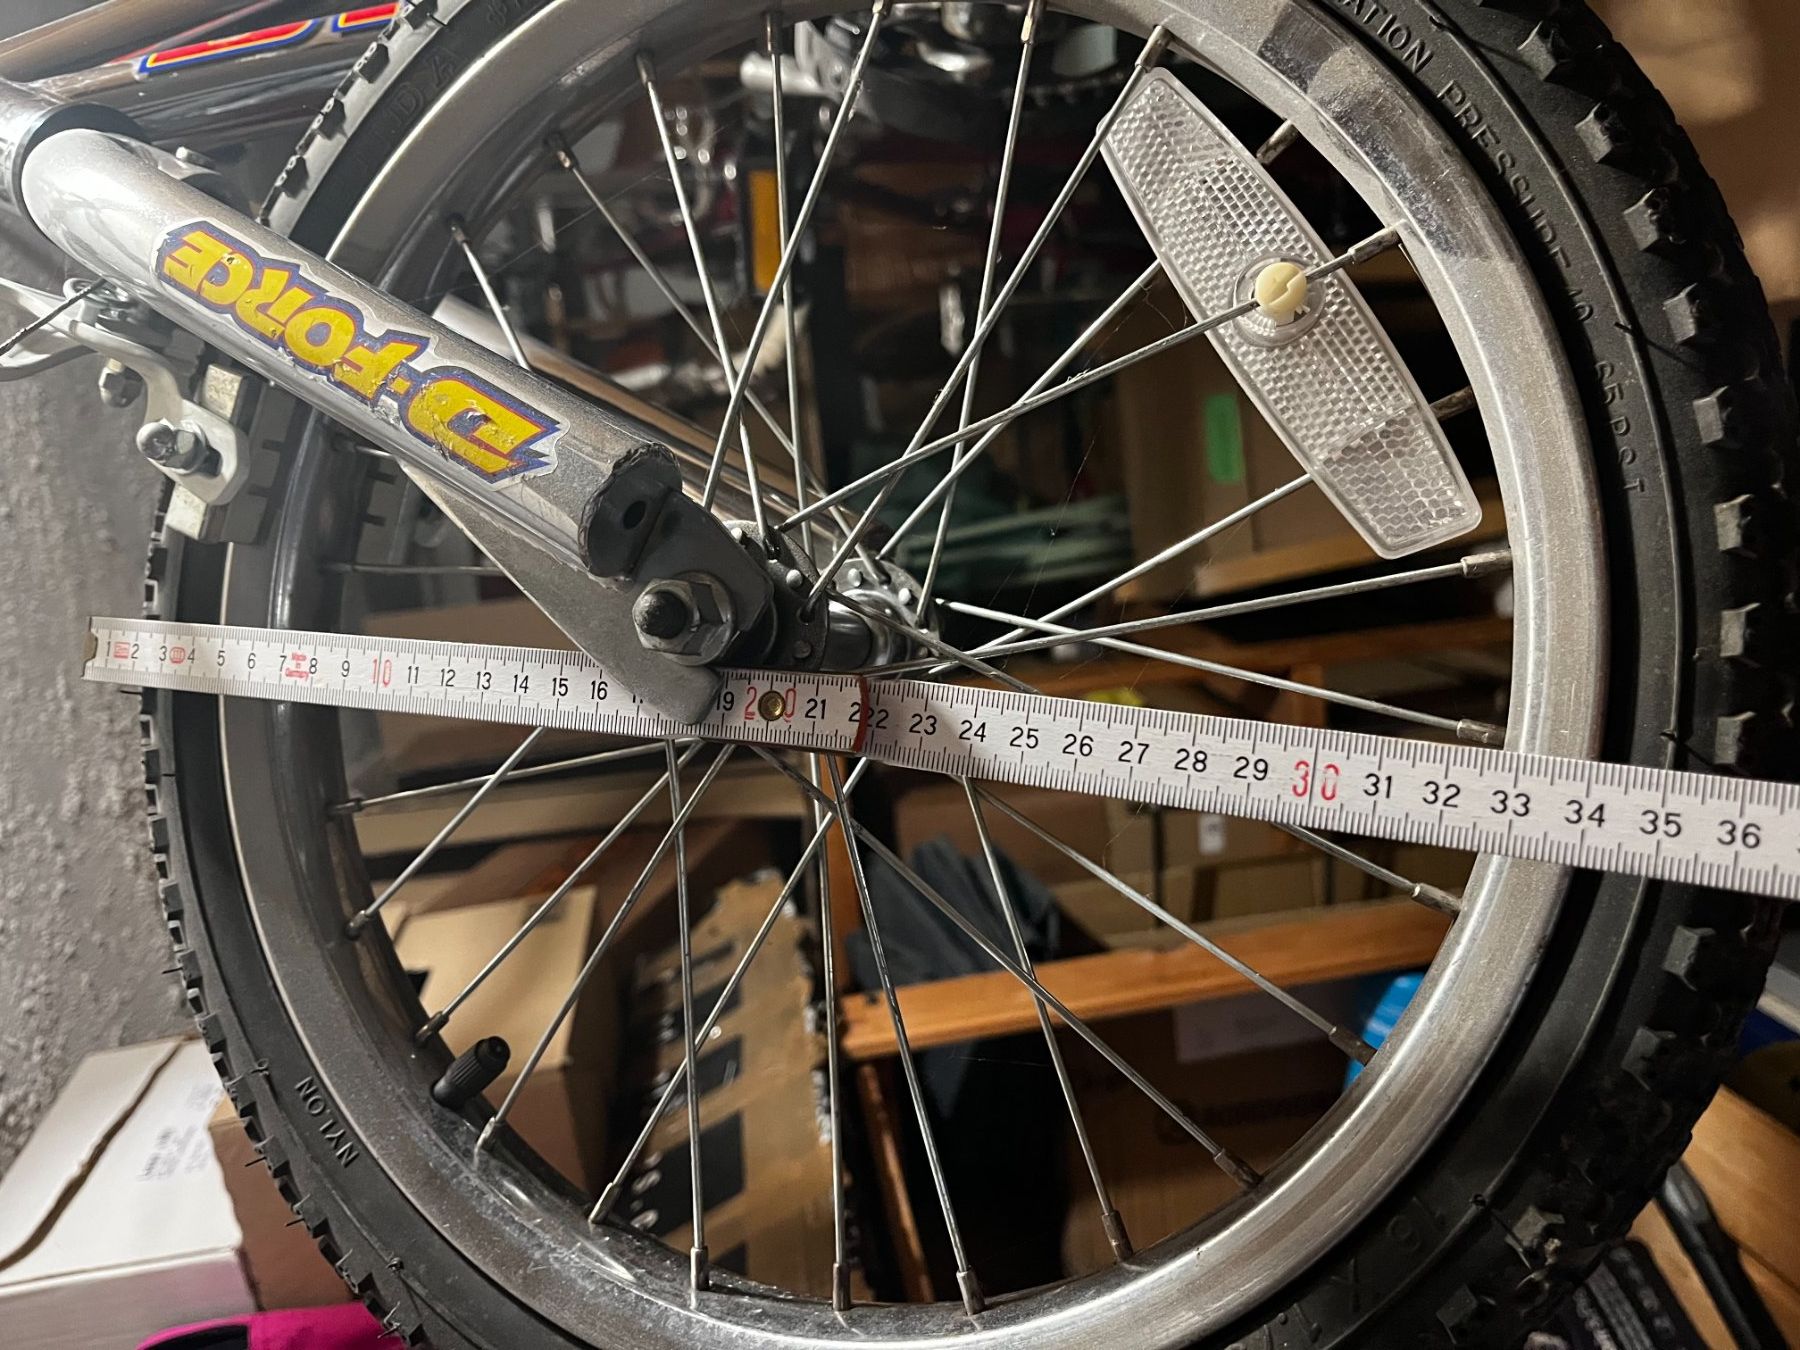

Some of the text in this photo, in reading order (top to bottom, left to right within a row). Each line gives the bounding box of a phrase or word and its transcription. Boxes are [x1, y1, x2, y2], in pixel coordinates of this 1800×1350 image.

[131, 643, 140, 660] 2
[159, 646, 167, 662] 3
[187, 648, 195, 664] 4
[216, 650, 225, 667] 5
[247, 653, 256, 669] 6
[279, 655, 287, 672] 7
[308, 658, 318, 675] 8
[341, 660, 350, 677] 9
[372, 658, 393, 687] 10
[408, 665, 420, 684] 11
[440, 668, 456, 687] 12
[476, 671, 492, 690] 13
[513, 674, 529, 694] 14
[552, 677, 569, 696] 15
[591, 681, 608, 700] 16
[744, 686, 797, 722] 20
[804, 698, 827, 719] 21
[909, 713, 937, 735] 23
[958, 720, 987, 742] 24
[1009, 726, 1039, 749] 25
[1062, 733, 1094, 757] 26
[1118, 740, 1150, 764] 27
[1174, 748, 1208, 773] 28
[1233, 756, 1269, 781] 29
[1292, 760, 1340, 801] 30
[1363, 773, 1393, 799] 31
[1422, 781, 1461, 808] 32
[1490, 790, 1531, 817] 33
[1564, 800, 1605, 828] 34
[1639, 809, 1682, 838] 35
[1717, 820, 1761, 849] 36
[295, 1075, 360, 1169] NYLON
